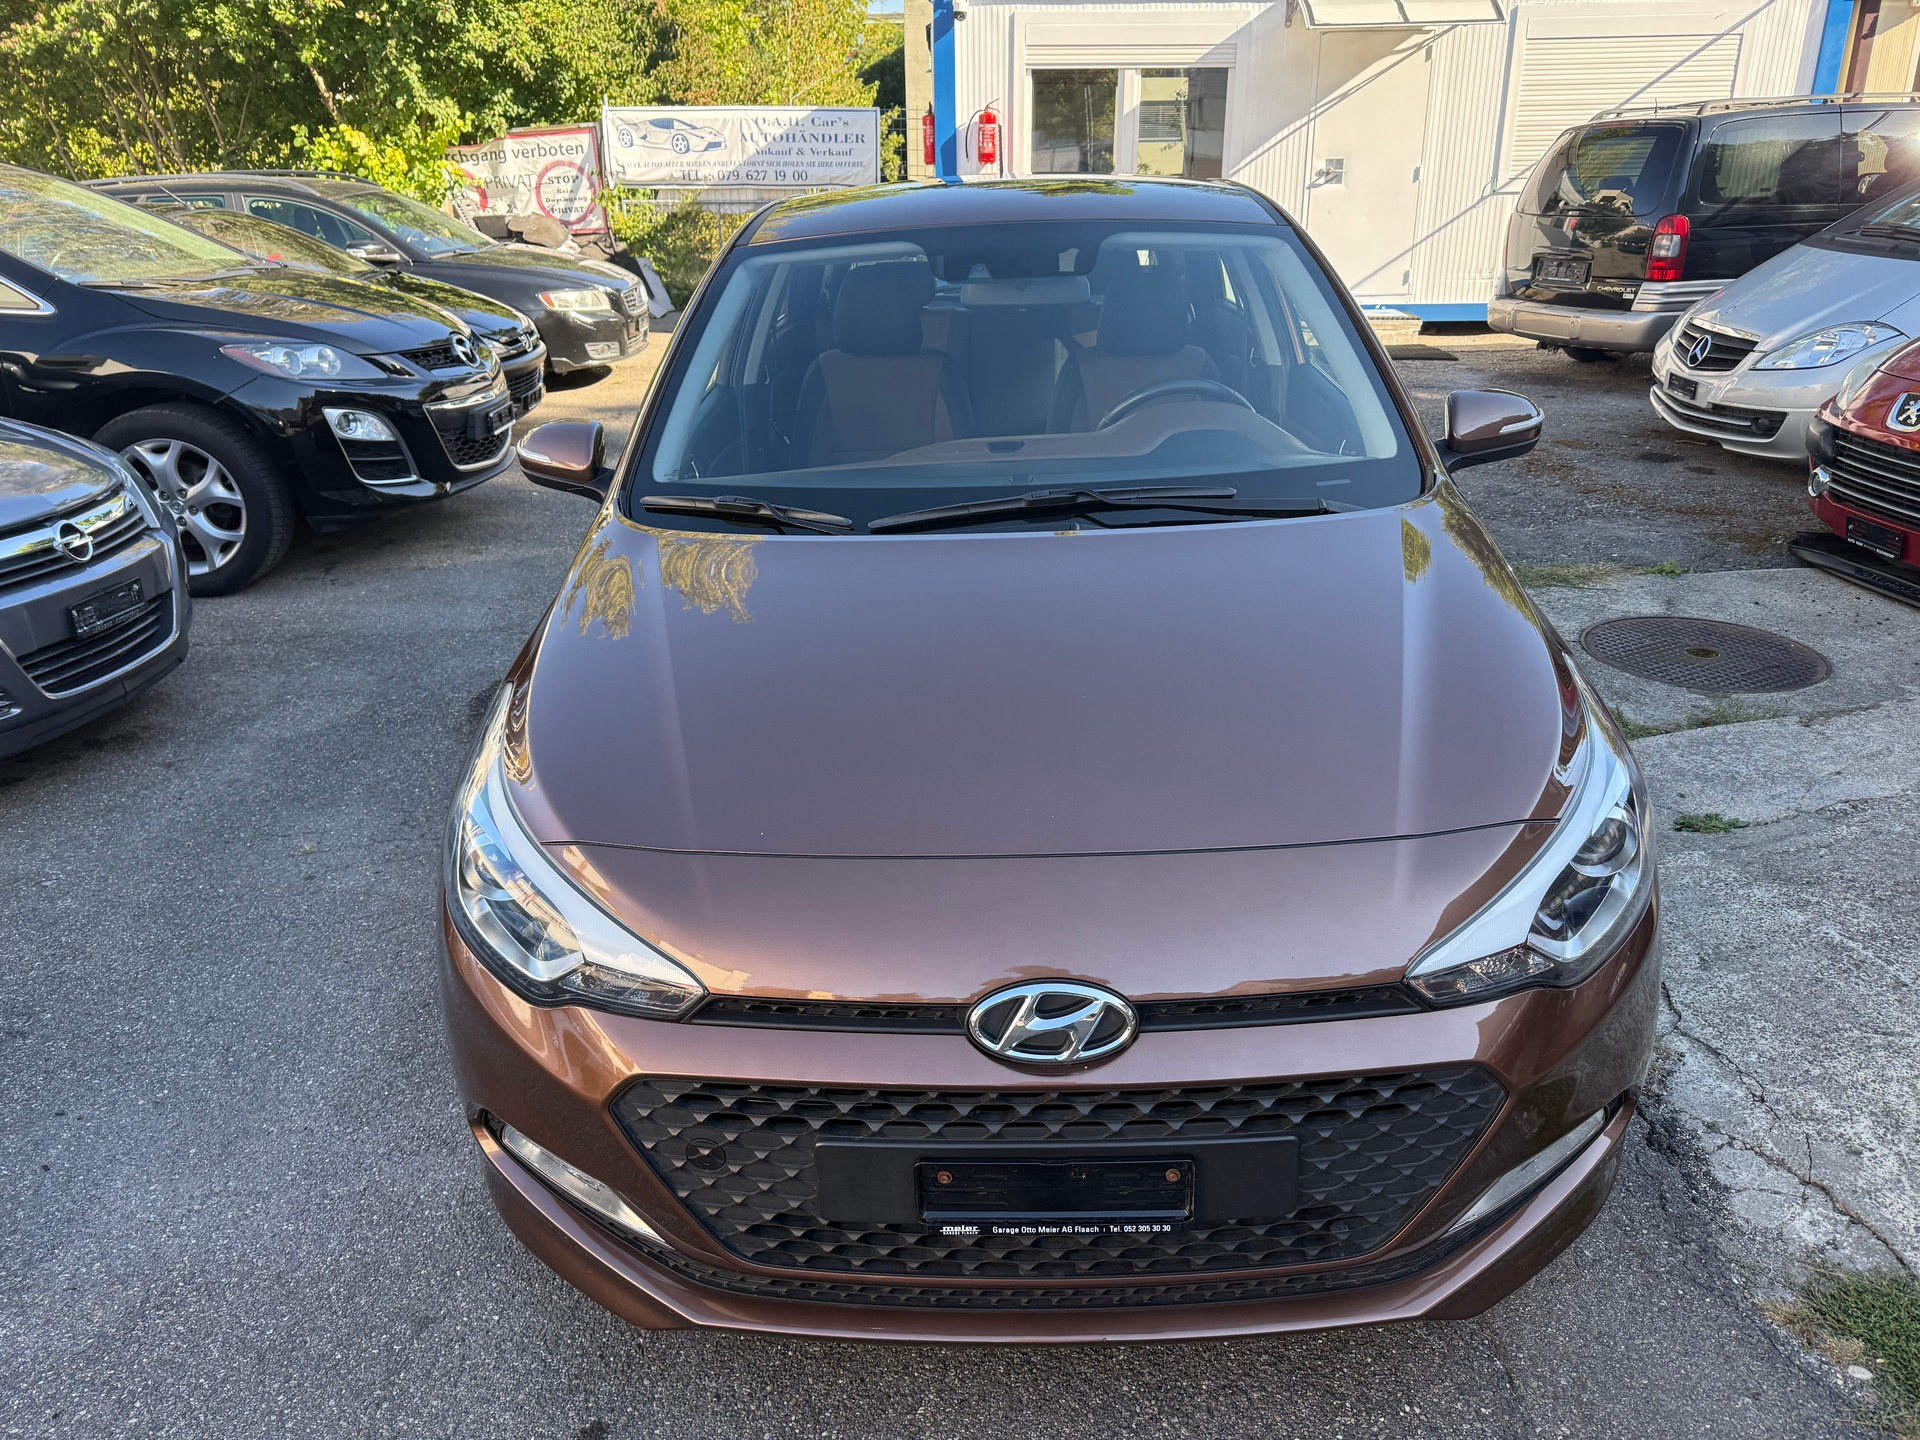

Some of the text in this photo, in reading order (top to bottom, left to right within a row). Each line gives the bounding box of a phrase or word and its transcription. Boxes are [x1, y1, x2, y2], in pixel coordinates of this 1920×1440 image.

[811, 116, 849, 127] Car's
[742, 130, 866, 144] AUTOHÄNDLER
[511, 143, 584, 159] verboten
[755, 147, 854, 156] Ankauf & Verkauf
[548, 175, 579, 184] STOP
[717, 169, 740, 181] 079
[746, 169, 767, 181] 627
[774, 169, 786, 181] 19
[792, 169, 808, 181] 00
[484, 174, 534, 189] PRIVAT
[992, 1226, 1019, 1234] Garage
[1075, 1225, 1099, 1233] Flaach
